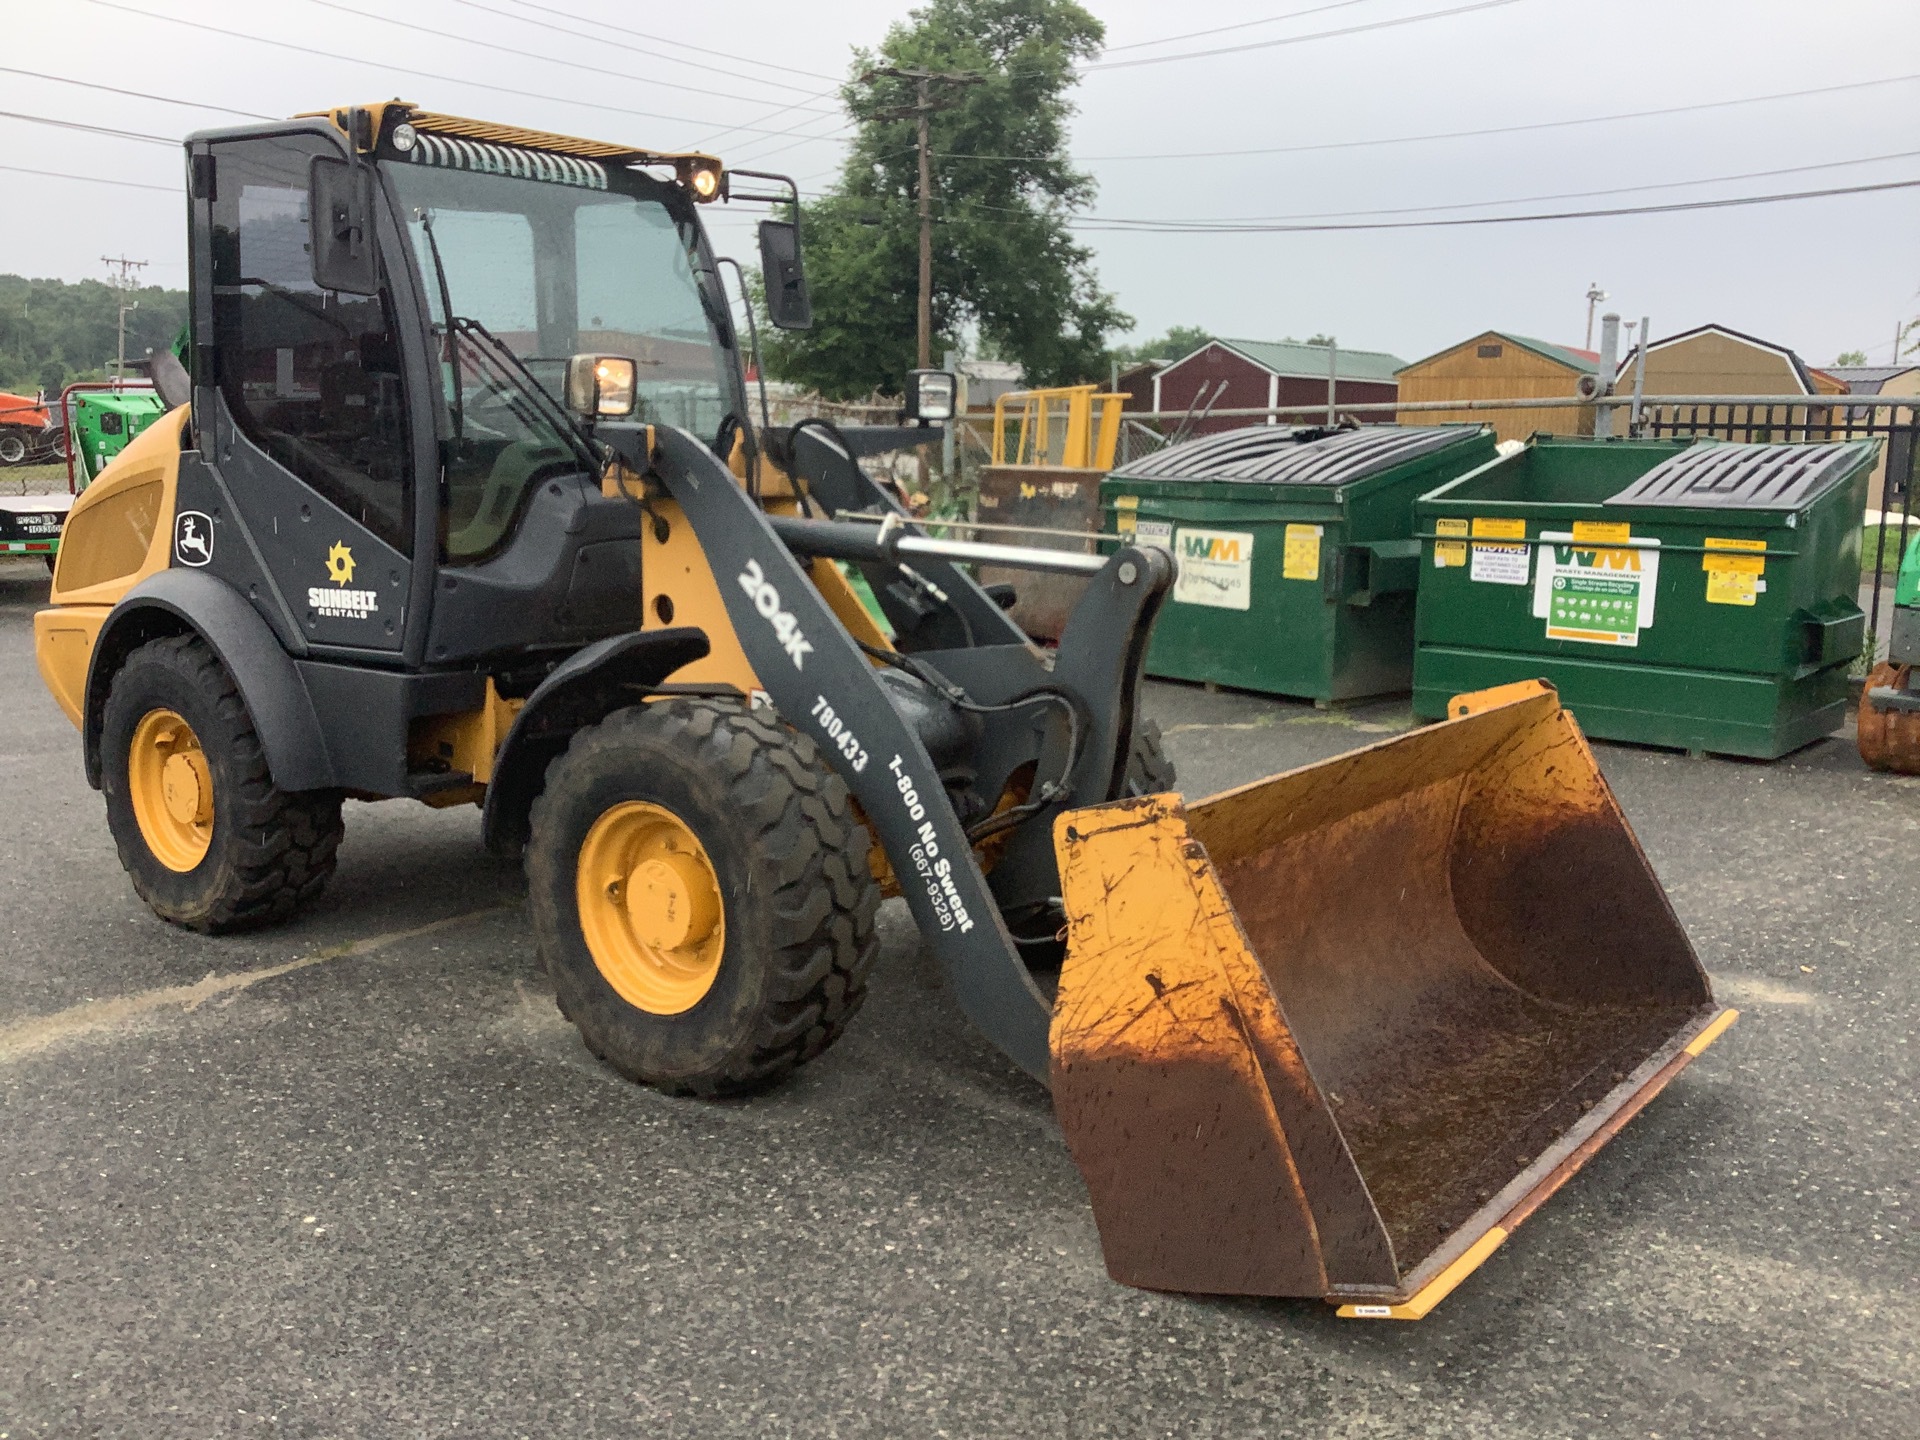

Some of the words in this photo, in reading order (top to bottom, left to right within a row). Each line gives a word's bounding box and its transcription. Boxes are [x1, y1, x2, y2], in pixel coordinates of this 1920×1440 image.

[1185, 536, 1239, 562] WM
[1553, 545, 1641, 571] WM
[1571, 579, 1587, 587] Single
[1588, 580, 1607, 588] Stream
[1608, 582, 1634, 591] Recycling
[1584, 570, 1641, 580] MANAGEMENT
[308, 587, 377, 611] SUNBELT
[318, 607, 368, 619] RENTALS
[737, 557, 815, 672] 204K
[810, 694, 869, 772] 780433
[888, 754, 925, 821] 1-800
[917, 821, 939, 858] No
[934, 858, 974, 934] Sweat
[908, 843, 955, 932] (667-9328)
